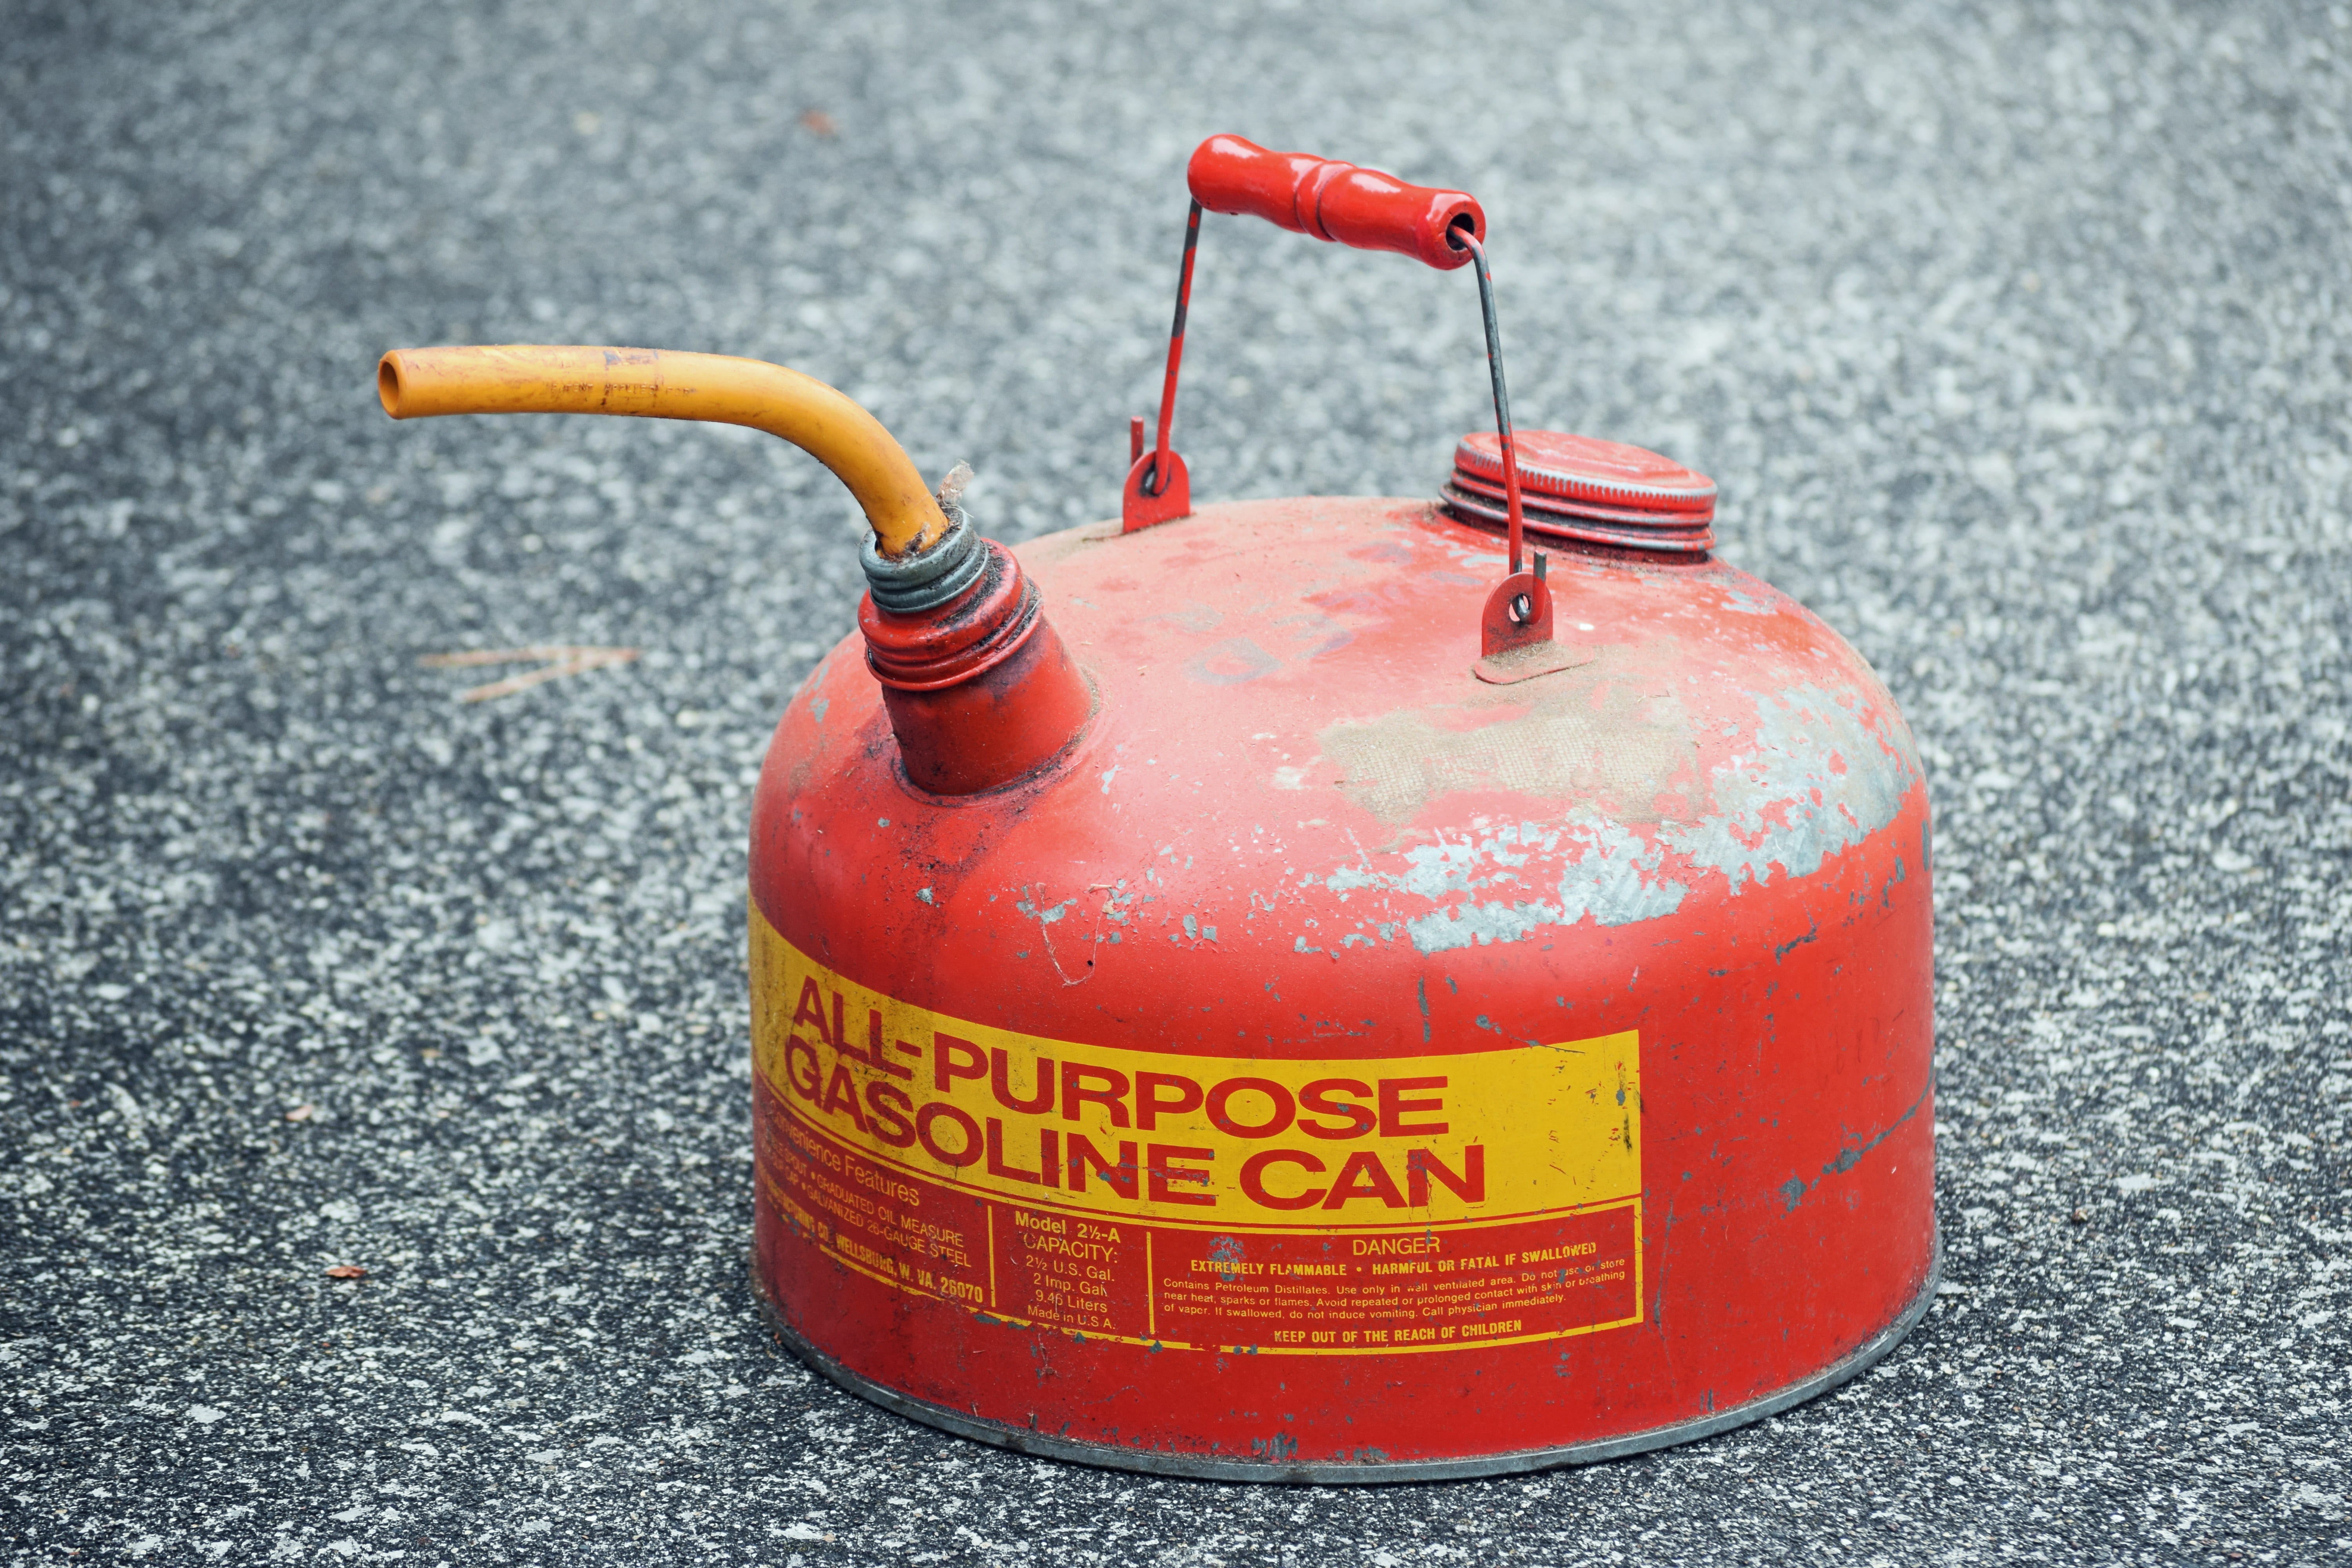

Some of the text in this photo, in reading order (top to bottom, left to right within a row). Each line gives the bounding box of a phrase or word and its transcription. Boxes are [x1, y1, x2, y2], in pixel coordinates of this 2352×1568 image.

[794, 975, 1449, 1140] ALL-PURPOSE
[786, 1034, 1485, 1210] GASOLINE CAN
[845, 1155, 919, 1206] Features
[808, 1185, 864, 1227] GALVANIZED
[867, 1220, 925, 1253] 26-GAUGE
[930, 1243, 971, 1267] STEEL
[817, 1174, 874, 1214] GRADUATED
[878, 1207, 897, 1225] OIL
[901, 1214, 964, 1248] MEASURE
[1015, 1211, 1066, 1234] Model
[1024, 1232, 1118, 1263] CAPACITY:
[1191, 1242, 1596, 1276] EXTREMELY FLAMMABLE HARMFUL OR FATAL IF SWALLOWED
[1353, 1236, 1440, 1255] DANGER
[899, 1262, 913, 1282] W.
[917, 1269, 936, 1290] VA.
[941, 1276, 983, 1303] 26070
[1034, 1273, 1041, 1285] 2
[1046, 1275, 1074, 1293] Imp.
[1054, 1260, 1082, 1276] U.S.
[1087, 1266, 1114, 1281] Gal.
[1164, 1278, 1209, 1290] Contains
[1216, 1282, 1269, 1293] Petroleum
[1275, 1285, 1330, 1294] Distillates.
[1337, 1286, 1356, 1294] Use
[1362, 1285, 1385, 1295] only
[1391, 1284, 1400, 1293] in
[1434, 1278, 1485, 1290] ventilated
[1490, 1276, 1516, 1286] area.
[1522, 1273, 1535, 1282] Do
[1541, 1270, 1557, 1279] not
[1601, 1259, 1625, 1269] store
[1036, 1290, 1107, 1313] 9.46 Liters
[1164, 1292, 1187, 1300] near
[1191, 1293, 1216, 1304] heat,
[1221, 1296, 1255, 1305] sparks
[1275, 1298, 1312, 1307] flames.
[1316, 1298, 1347, 1307] Avoid
[1351, 1297, 1398, 1308] repeated
[1417, 1292, 1470, 1306] prolonged
[1474, 1289, 1513, 1300] contact
[1517, 1284, 1537, 1294] with
[1541, 1282, 1561, 1291] skin
[1579, 1271, 1625, 1285] breathing
[1028, 1305, 1060, 1321] Made
[1063, 1314, 1074, 1323] in
[1216, 1307, 1222, 1316] If
[1227, 1308, 1285, 1319] swallowed,
[1290, 1310, 1303, 1318] do
[1329, 1310, 1365, 1319] induce
[1370, 1308, 1418, 1319] vomiting.
[1423, 1307, 1443, 1316] Call
[1448, 1303, 1497, 1316] physician
[1503, 1293, 1566, 1309] immediately.
[1274, 1319, 1521, 1343] KEEP OUT OF THE REACH OF CHILDREN
